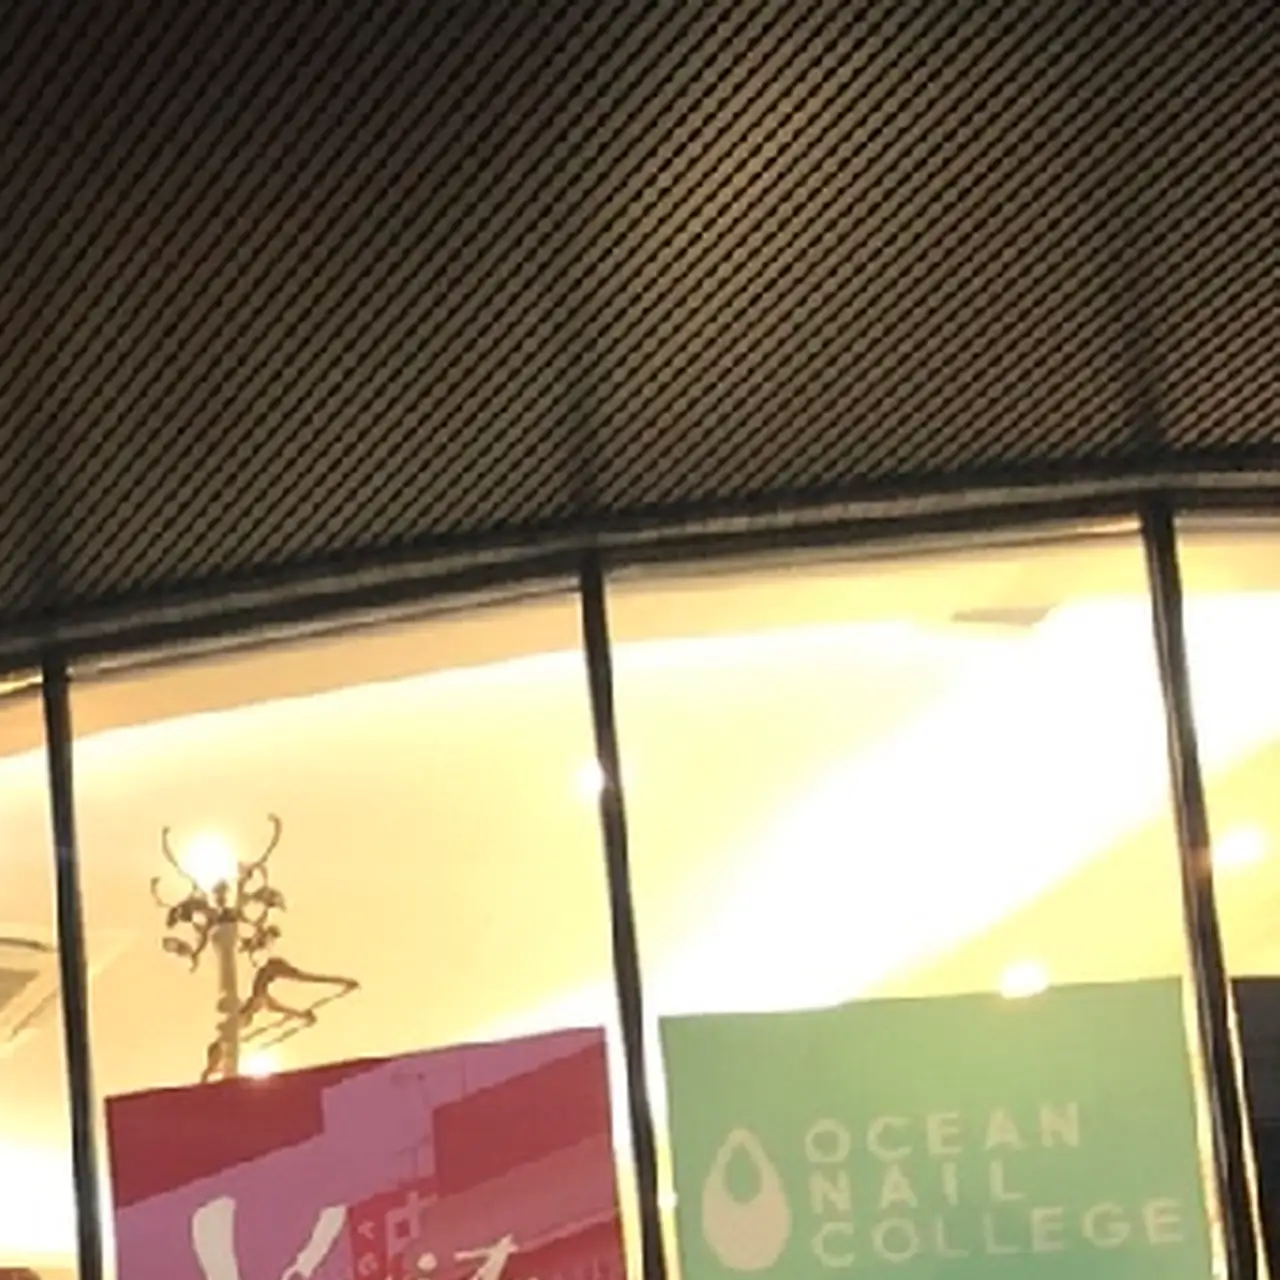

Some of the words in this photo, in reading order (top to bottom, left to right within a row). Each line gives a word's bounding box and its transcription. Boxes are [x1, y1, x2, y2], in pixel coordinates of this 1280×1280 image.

[804, 1102, 1081, 1163] OCEAN
[810, 1160, 1027, 1214] NAIL
[812, 1199, 1184, 1267] COLLEGE
